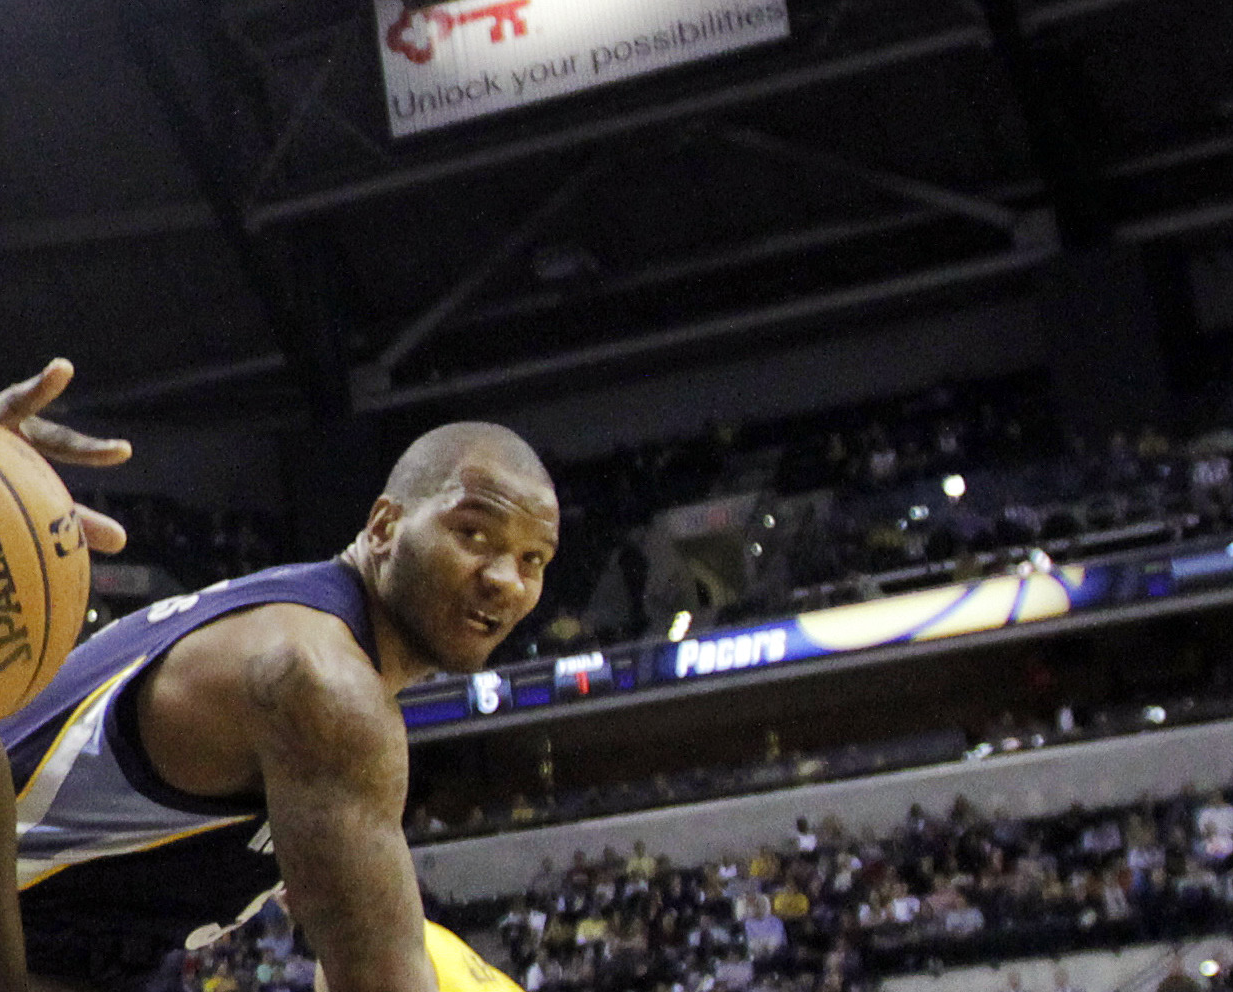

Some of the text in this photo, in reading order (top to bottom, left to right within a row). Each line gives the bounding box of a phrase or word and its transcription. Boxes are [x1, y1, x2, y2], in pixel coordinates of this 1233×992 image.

[392, 7, 784, 117] Unlock your possibilities
[675, 628, 786, 678] Pacers
